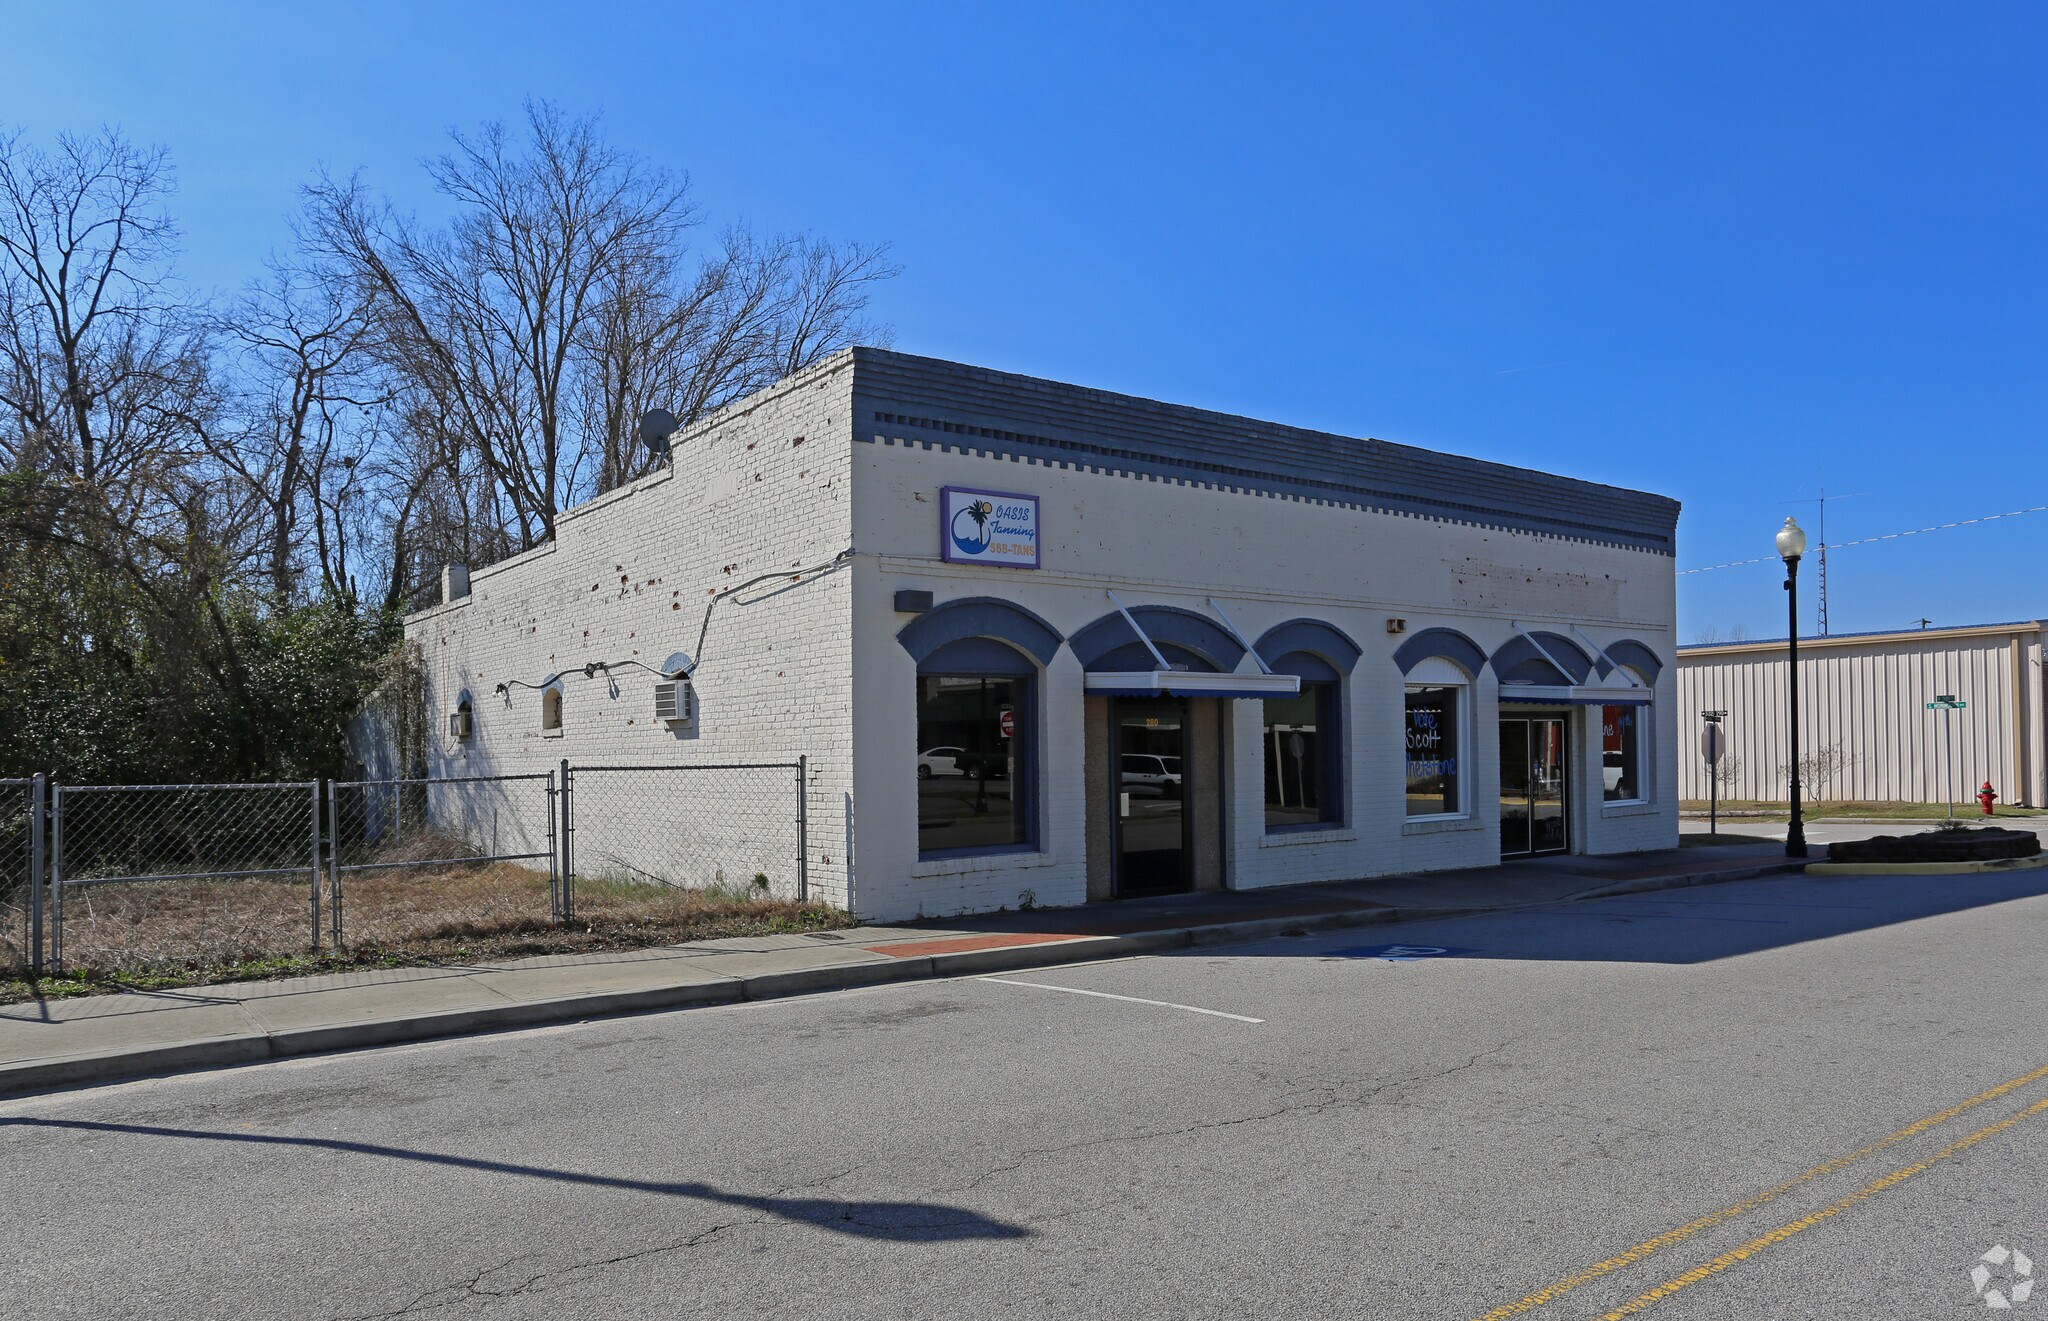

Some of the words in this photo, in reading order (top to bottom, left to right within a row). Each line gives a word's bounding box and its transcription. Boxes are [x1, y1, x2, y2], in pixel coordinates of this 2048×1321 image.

[995, 504, 1030, 521] OASIS
[990, 520, 1035, 541] Tanning
[989, 542, 1035, 556] 568-TANS
[1413, 706, 1438, 730] Vote
[1405, 727, 1441, 749] Scott
